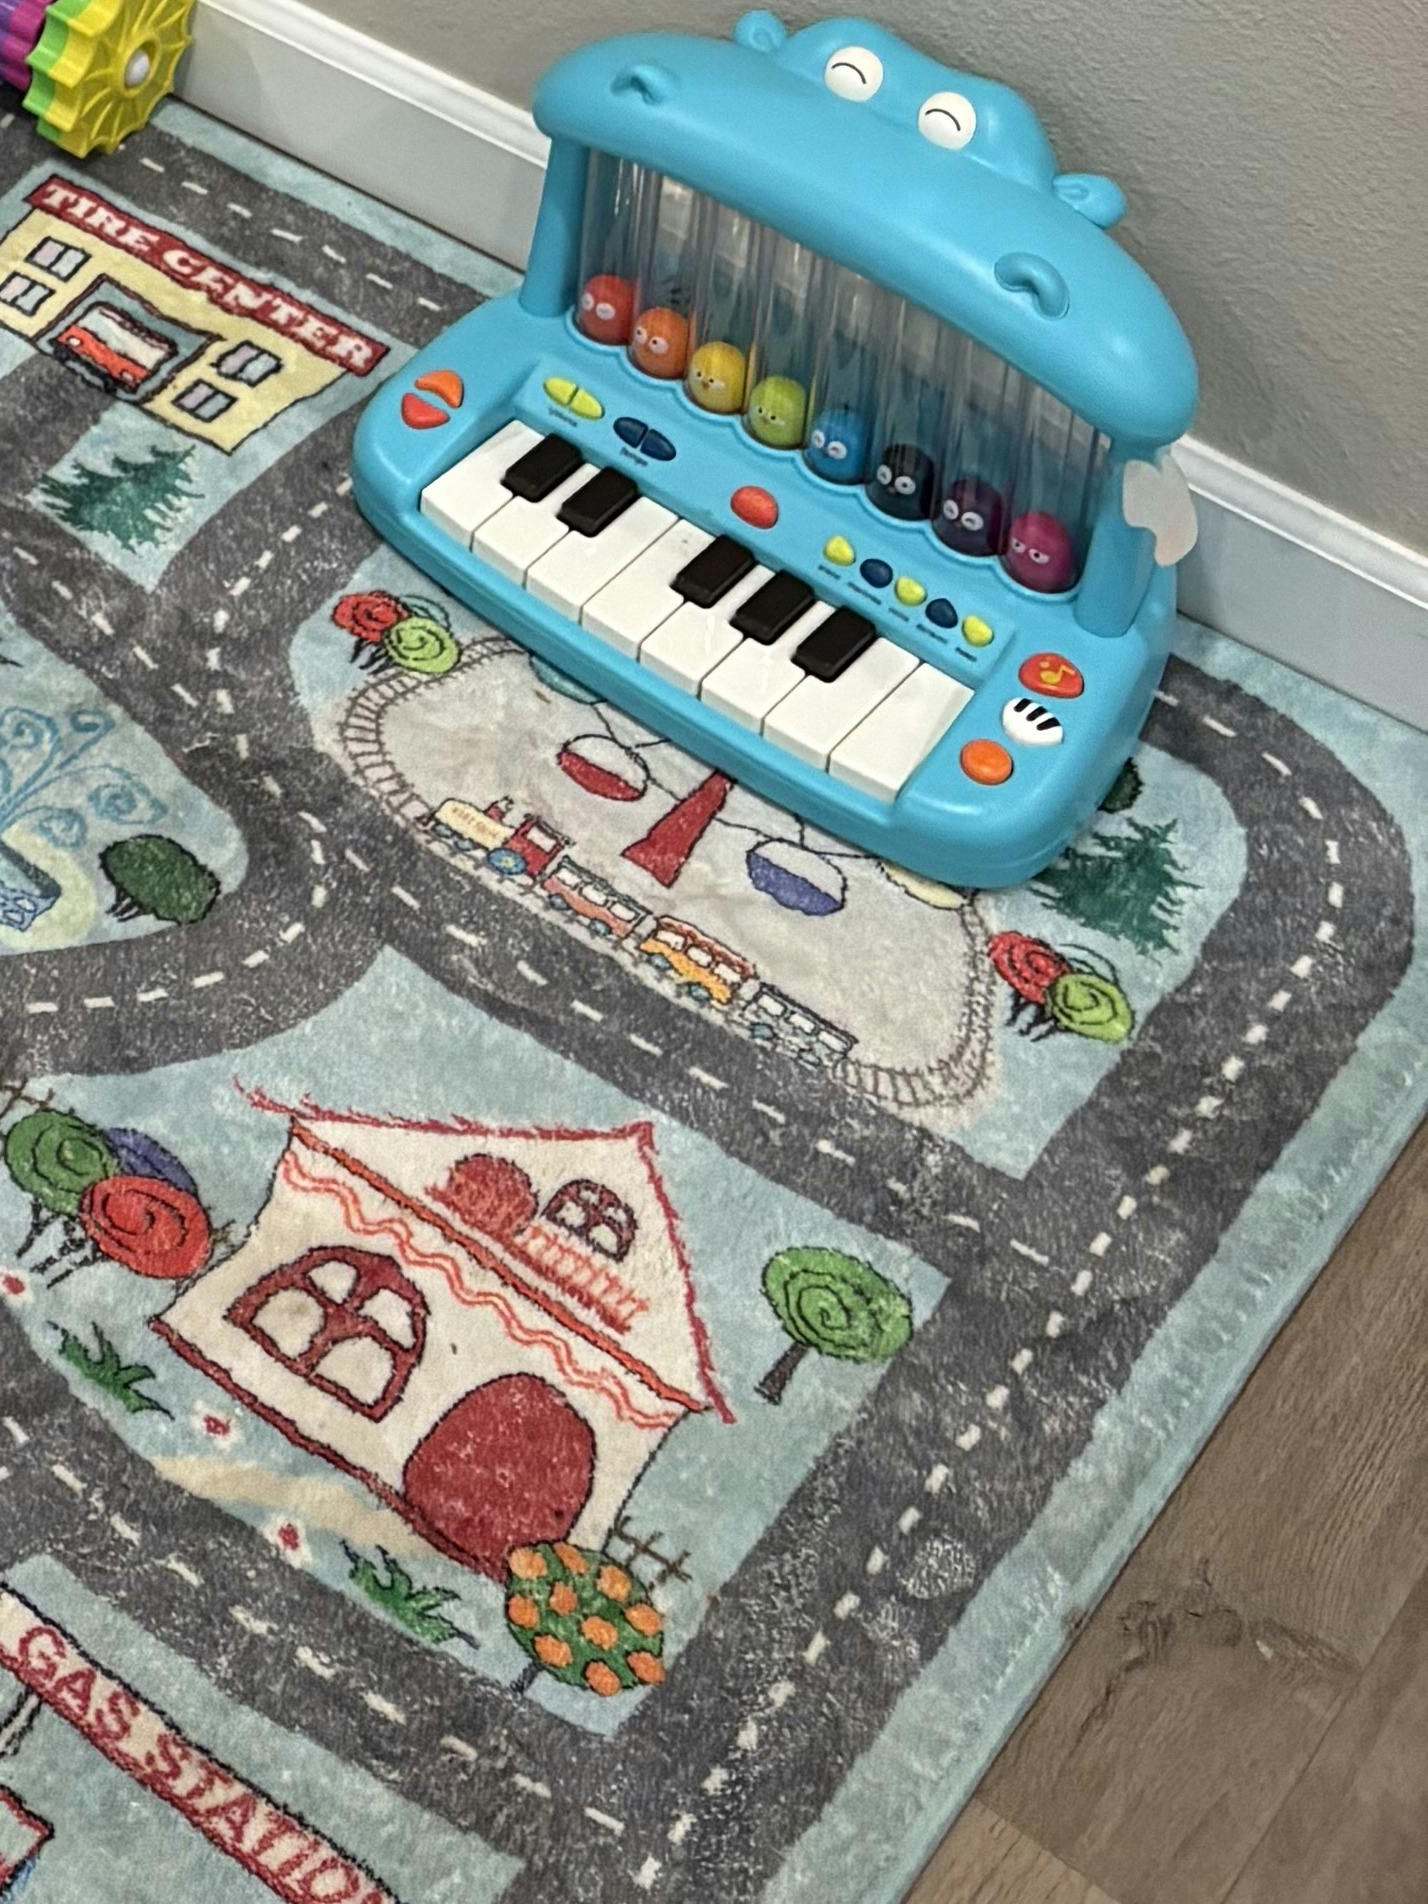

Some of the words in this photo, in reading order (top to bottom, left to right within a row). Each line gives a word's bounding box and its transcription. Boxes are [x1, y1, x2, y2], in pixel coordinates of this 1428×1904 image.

[43, 182, 165, 253] TIRE
[161, 245, 374, 369] CENTER
[15, 1625, 140, 1742] GAS
